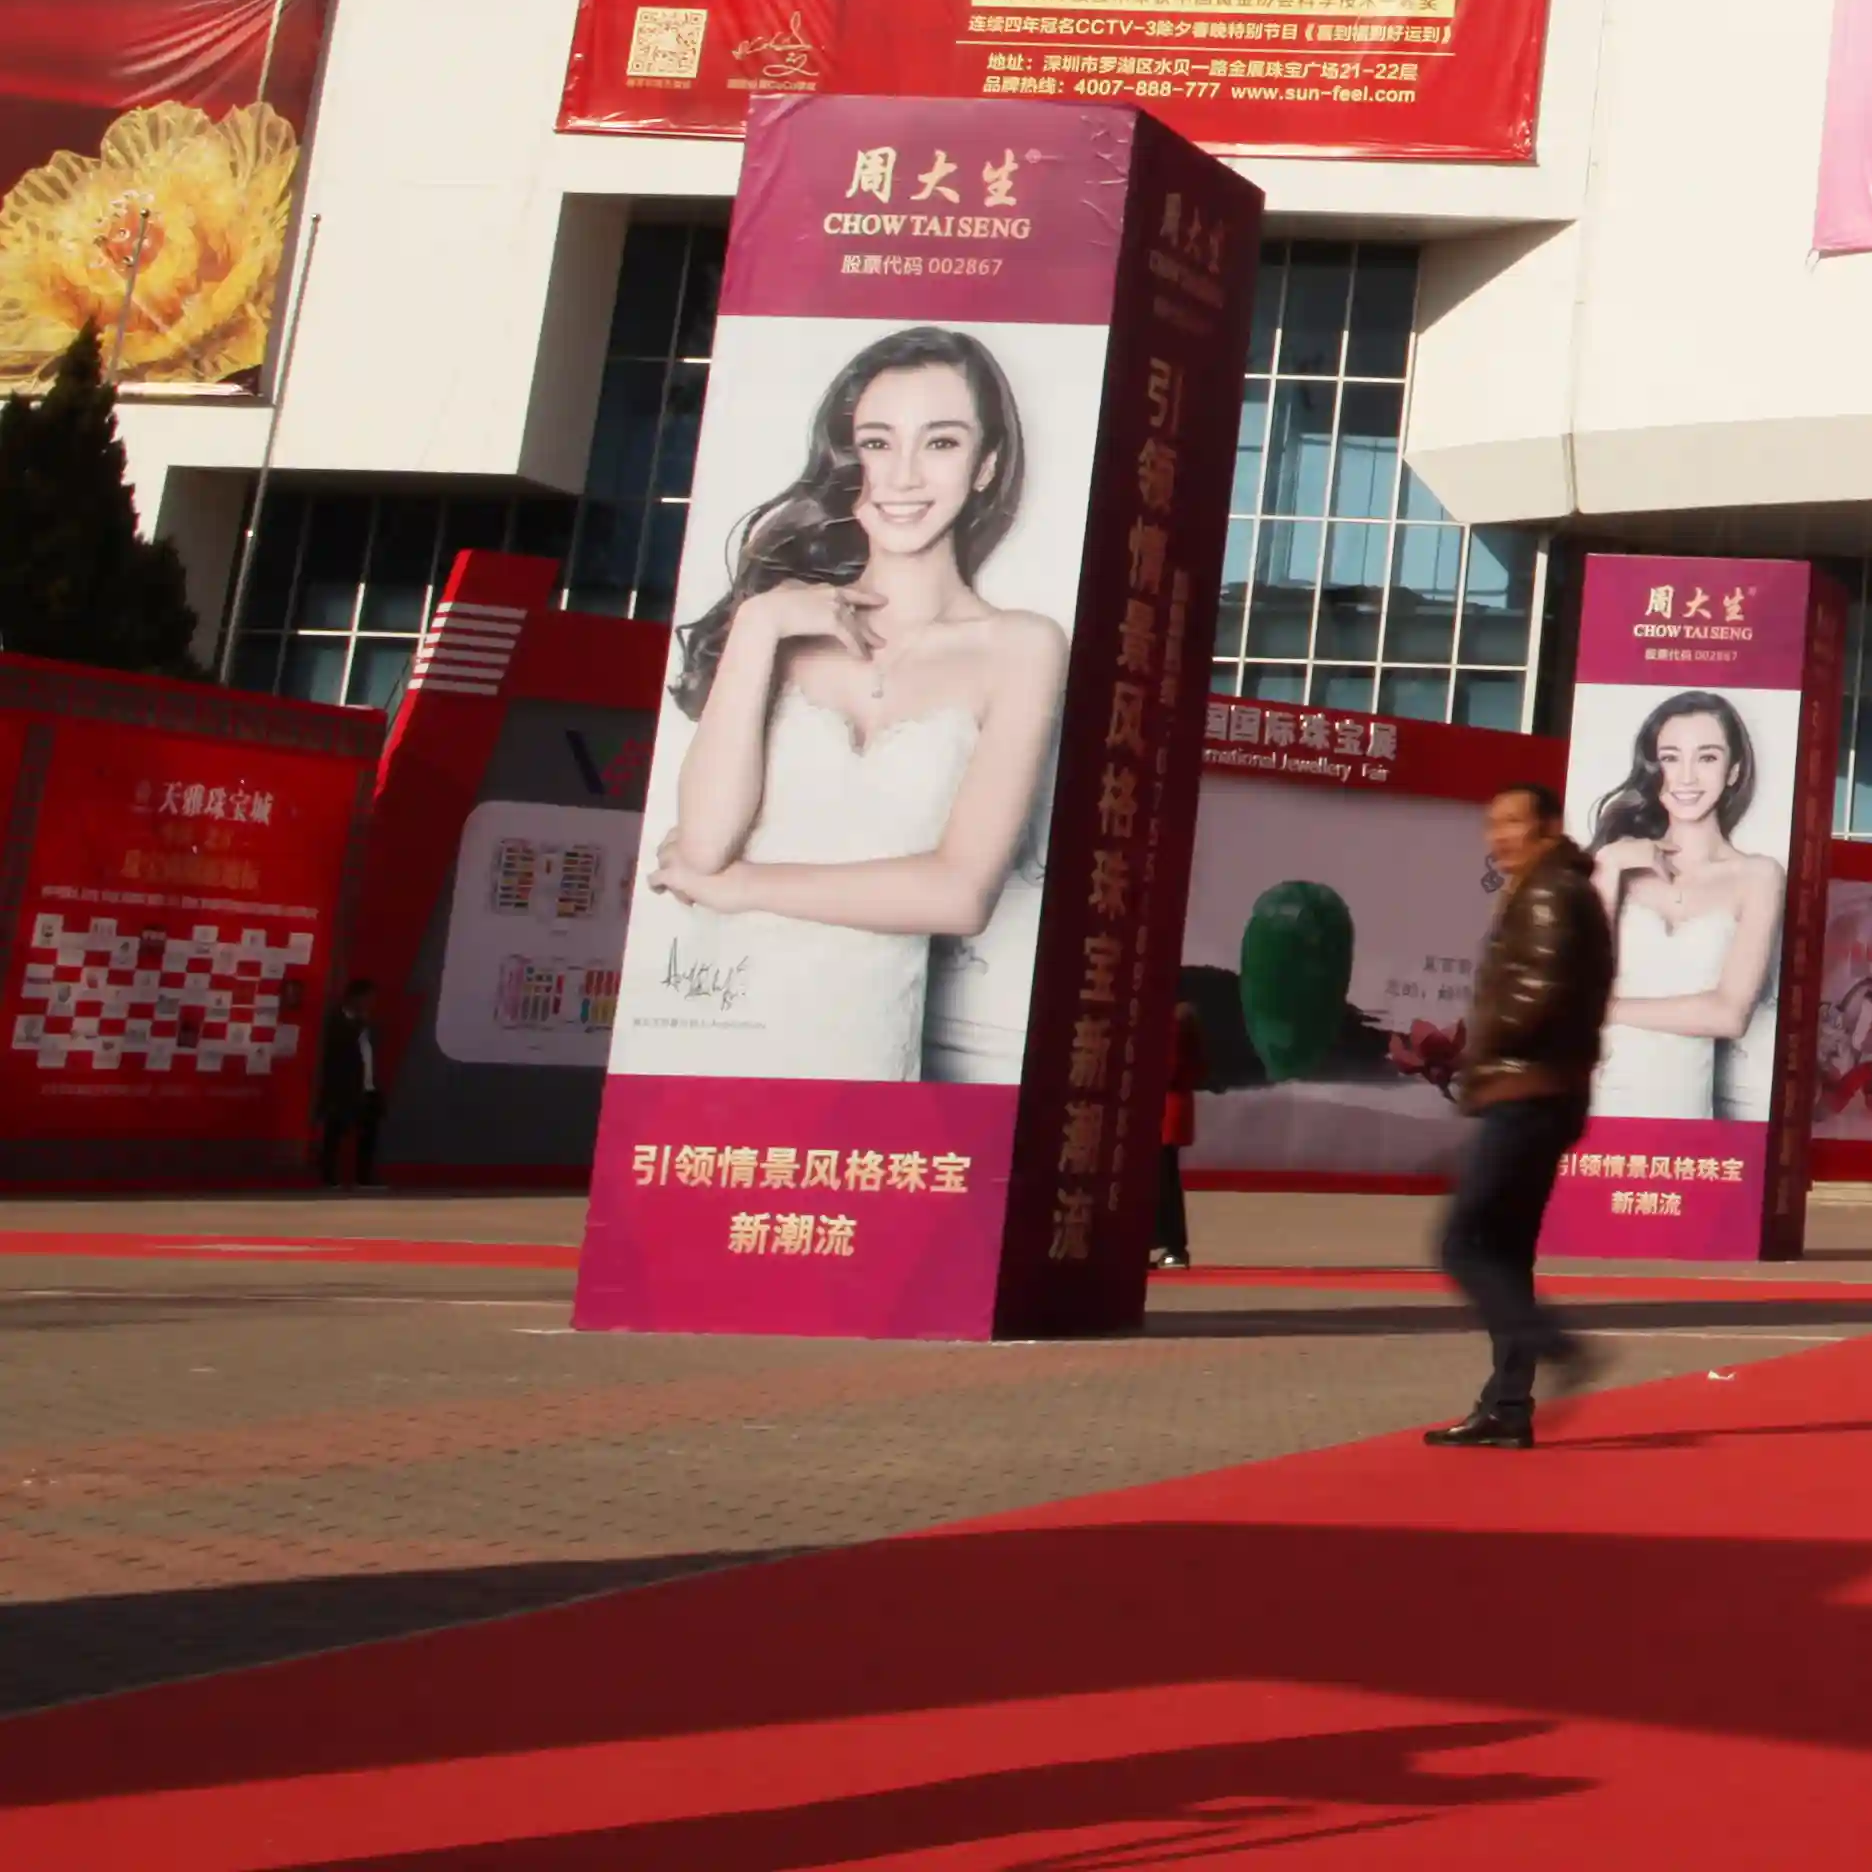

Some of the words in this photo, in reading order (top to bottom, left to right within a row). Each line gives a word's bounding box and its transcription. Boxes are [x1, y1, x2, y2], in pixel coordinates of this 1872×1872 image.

[1231, 84, 1415, 104] www.sun-feel.com
[845, 146, 1020, 209] 周大生
[823, 213, 905, 235] CHOW
[909, 215, 955, 237] TAI
[957, 216, 1032, 240] SENG
[841, 254, 923, 276] 股票代码
[927, 257, 1004, 277] 002867
[1645, 584, 1745, 622] 周大生
[1633, 624, 1682, 638] CHOW
[1683, 625, 1709, 639] TAI
[1710, 626, 1753, 640] SENG
[1205, 702, 1398, 761] 国国际珠宝展
[1279, 752, 1352, 783] Jewellery
[632, 1143, 972, 1196] 引领情景风格珠宝
[1558, 1152, 1745, 1182] 引领情景风格珠宝
[1610, 1190, 1683, 1217] 新潮流
[727, 1211, 858, 1258] 新潮流
